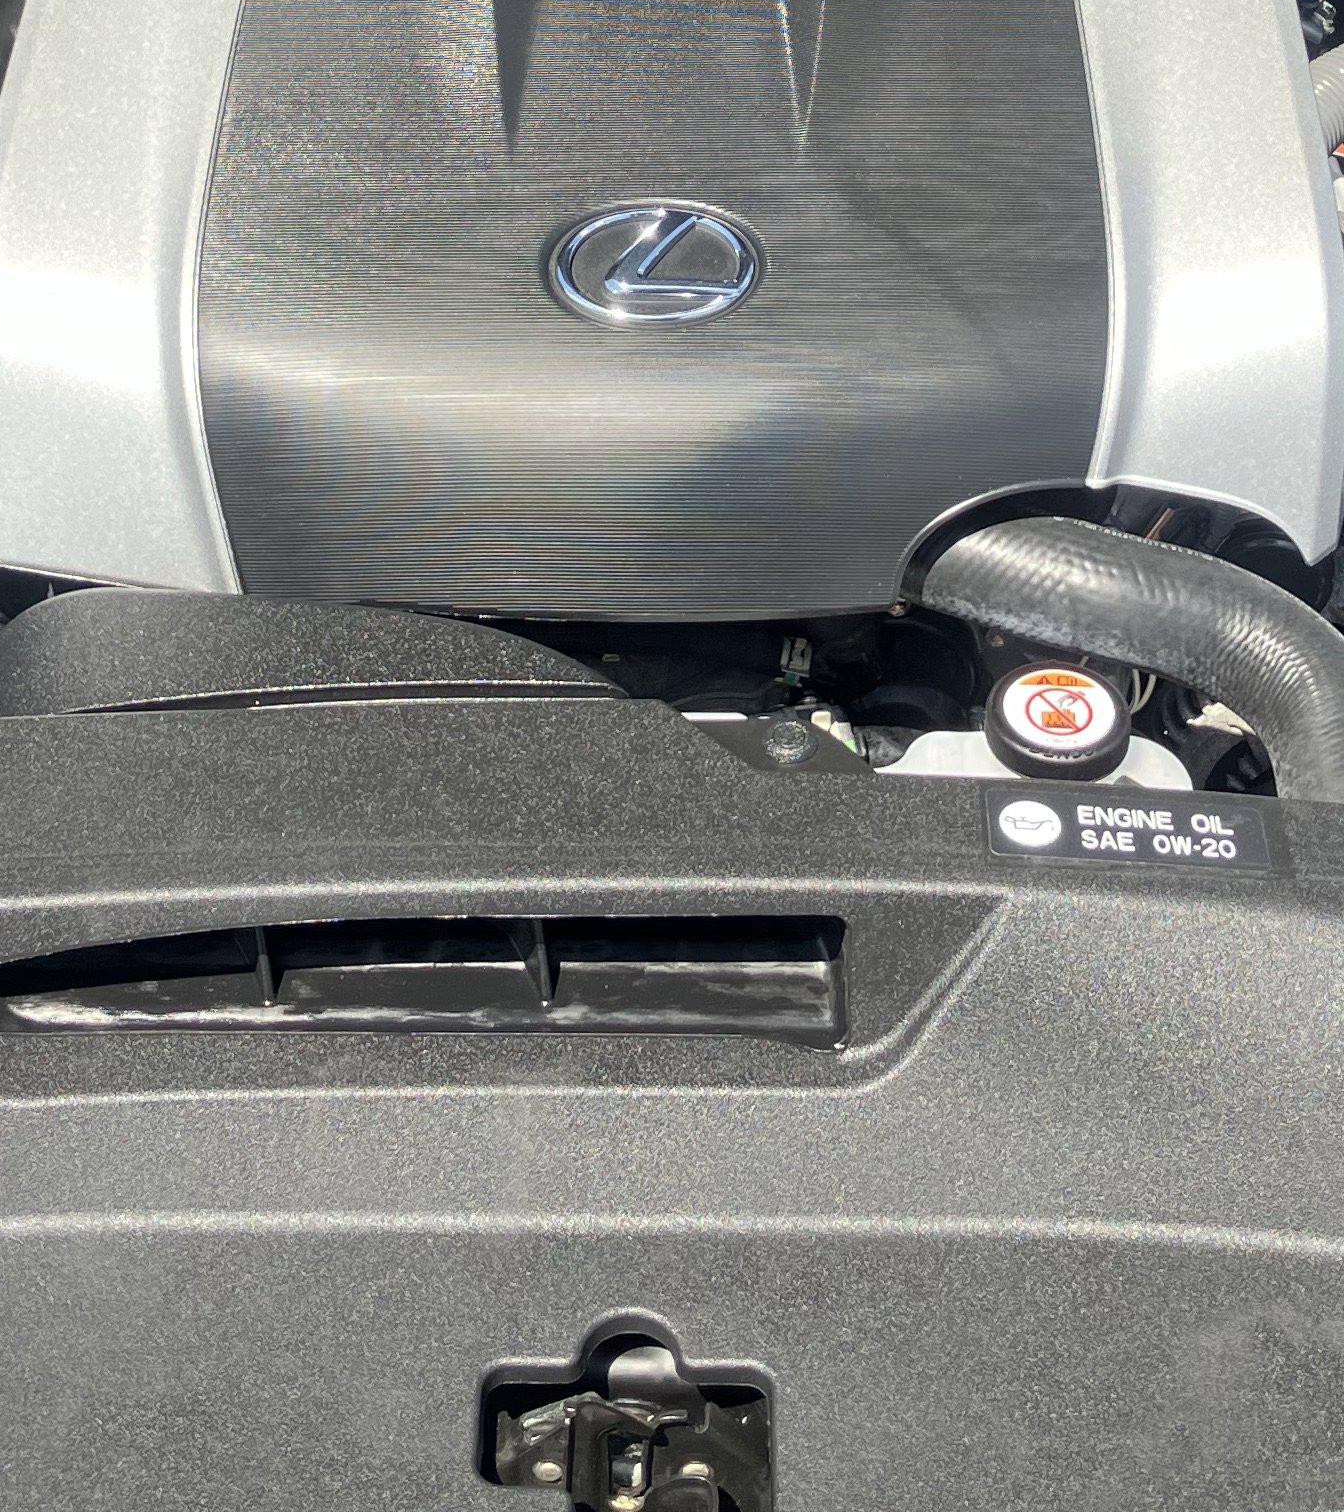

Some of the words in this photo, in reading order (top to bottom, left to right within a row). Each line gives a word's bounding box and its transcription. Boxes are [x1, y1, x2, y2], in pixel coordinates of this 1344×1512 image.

[1077, 805, 1174, 831] ENGINE
[1190, 813, 1235, 836] OIL
[1081, 829, 1136, 852] SAE
